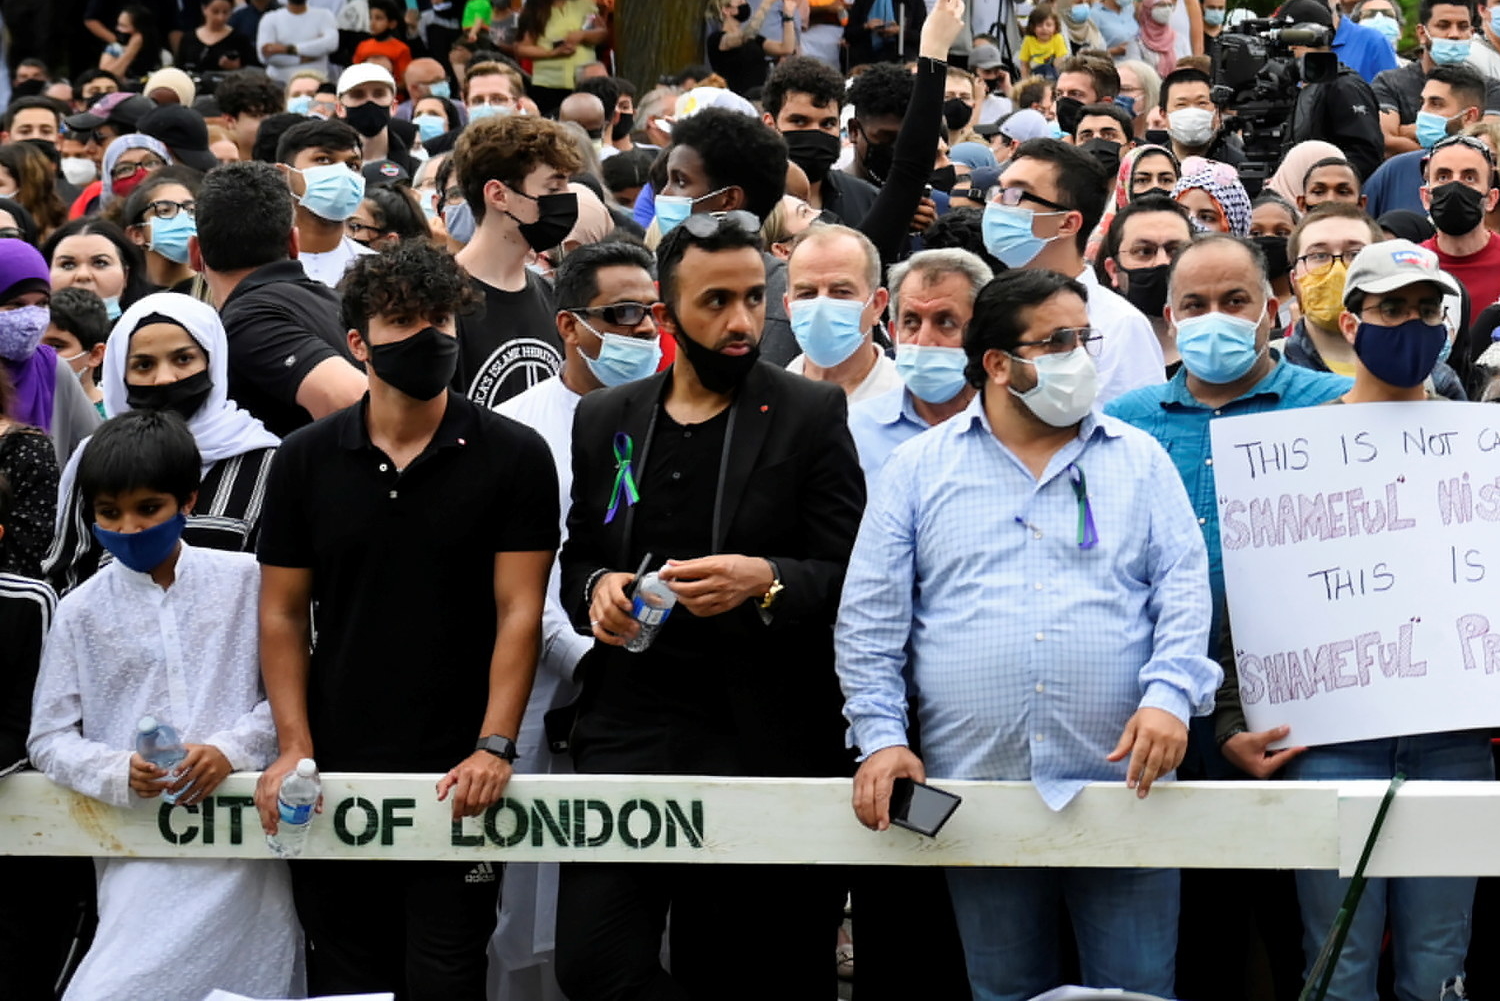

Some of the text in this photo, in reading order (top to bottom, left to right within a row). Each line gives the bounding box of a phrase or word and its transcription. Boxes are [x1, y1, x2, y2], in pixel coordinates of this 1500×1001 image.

[1234, 438, 1310, 479] THIS
[1341, 432, 1378, 465] IS
[1403, 427, 1459, 457] NOT
[1308, 563, 1395, 601] THIS
[1450, 546, 1486, 584] IS
[158, 795, 705, 850] CIT OF LONDON
